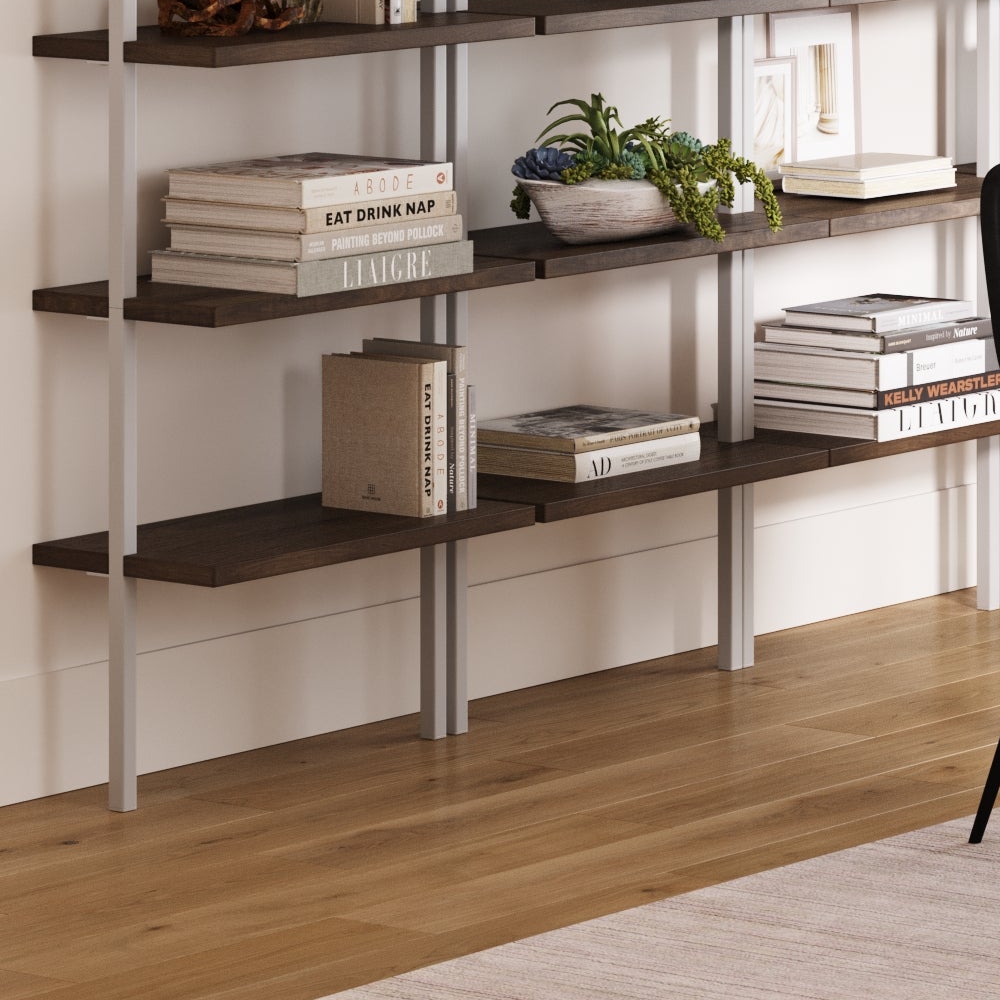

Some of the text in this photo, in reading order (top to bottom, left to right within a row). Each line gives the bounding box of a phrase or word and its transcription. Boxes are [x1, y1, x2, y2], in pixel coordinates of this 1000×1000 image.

[354, 174, 414, 196] ABODE
[325, 199, 436, 227] EAT DRINK NAP
[331, 235, 370, 252] PAINTING
[372, 229, 405, 246] BEYOND
[407, 223, 445, 242] POLLOCK
[343, 249, 433, 289] LIAIGRE
[897, 311, 944, 327] MINIMAL
[953, 326, 978, 339] Nature
[884, 387, 924, 407] KELLY
[436, 414, 445, 476] ABODE
[586, 456, 612, 479] AD
[424, 466, 432, 497] NAP
